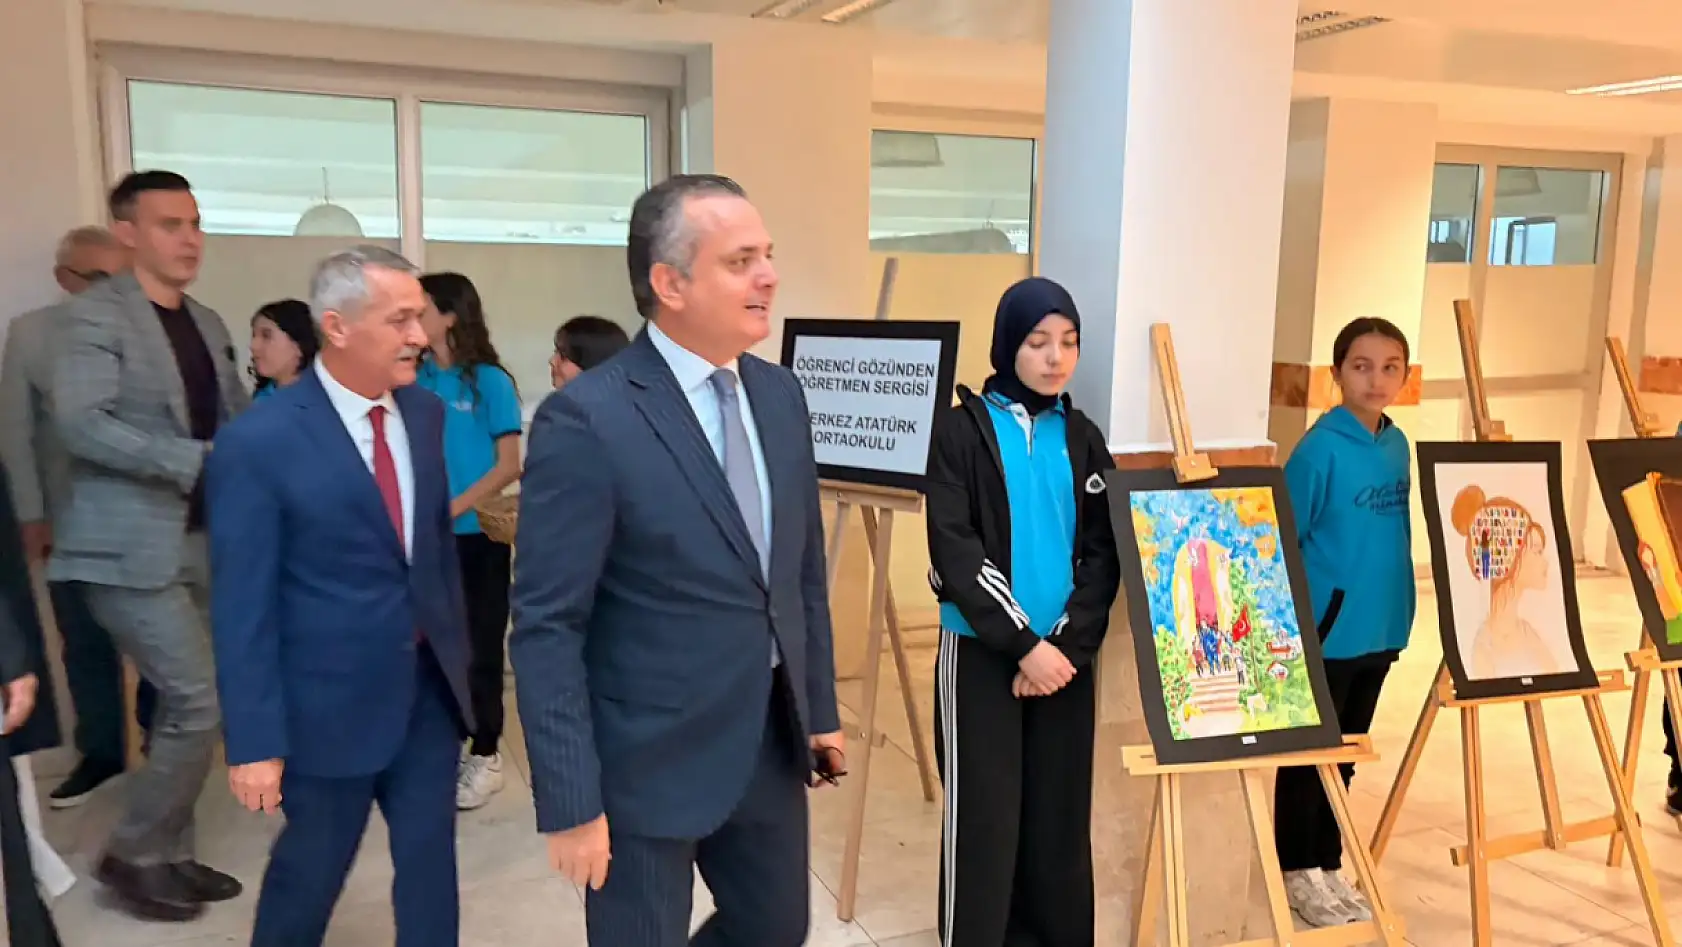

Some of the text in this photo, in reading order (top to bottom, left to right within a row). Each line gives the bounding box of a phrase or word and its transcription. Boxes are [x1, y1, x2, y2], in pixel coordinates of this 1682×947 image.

[797, 356, 935, 378] ÖĞRENCİ GÖZÜNDEN
[874, 379, 930, 397] SERGİSİ
[809, 411, 917, 434] ERKEZ ATATÜRK
[814, 431, 896, 451] ORTAOKULU
